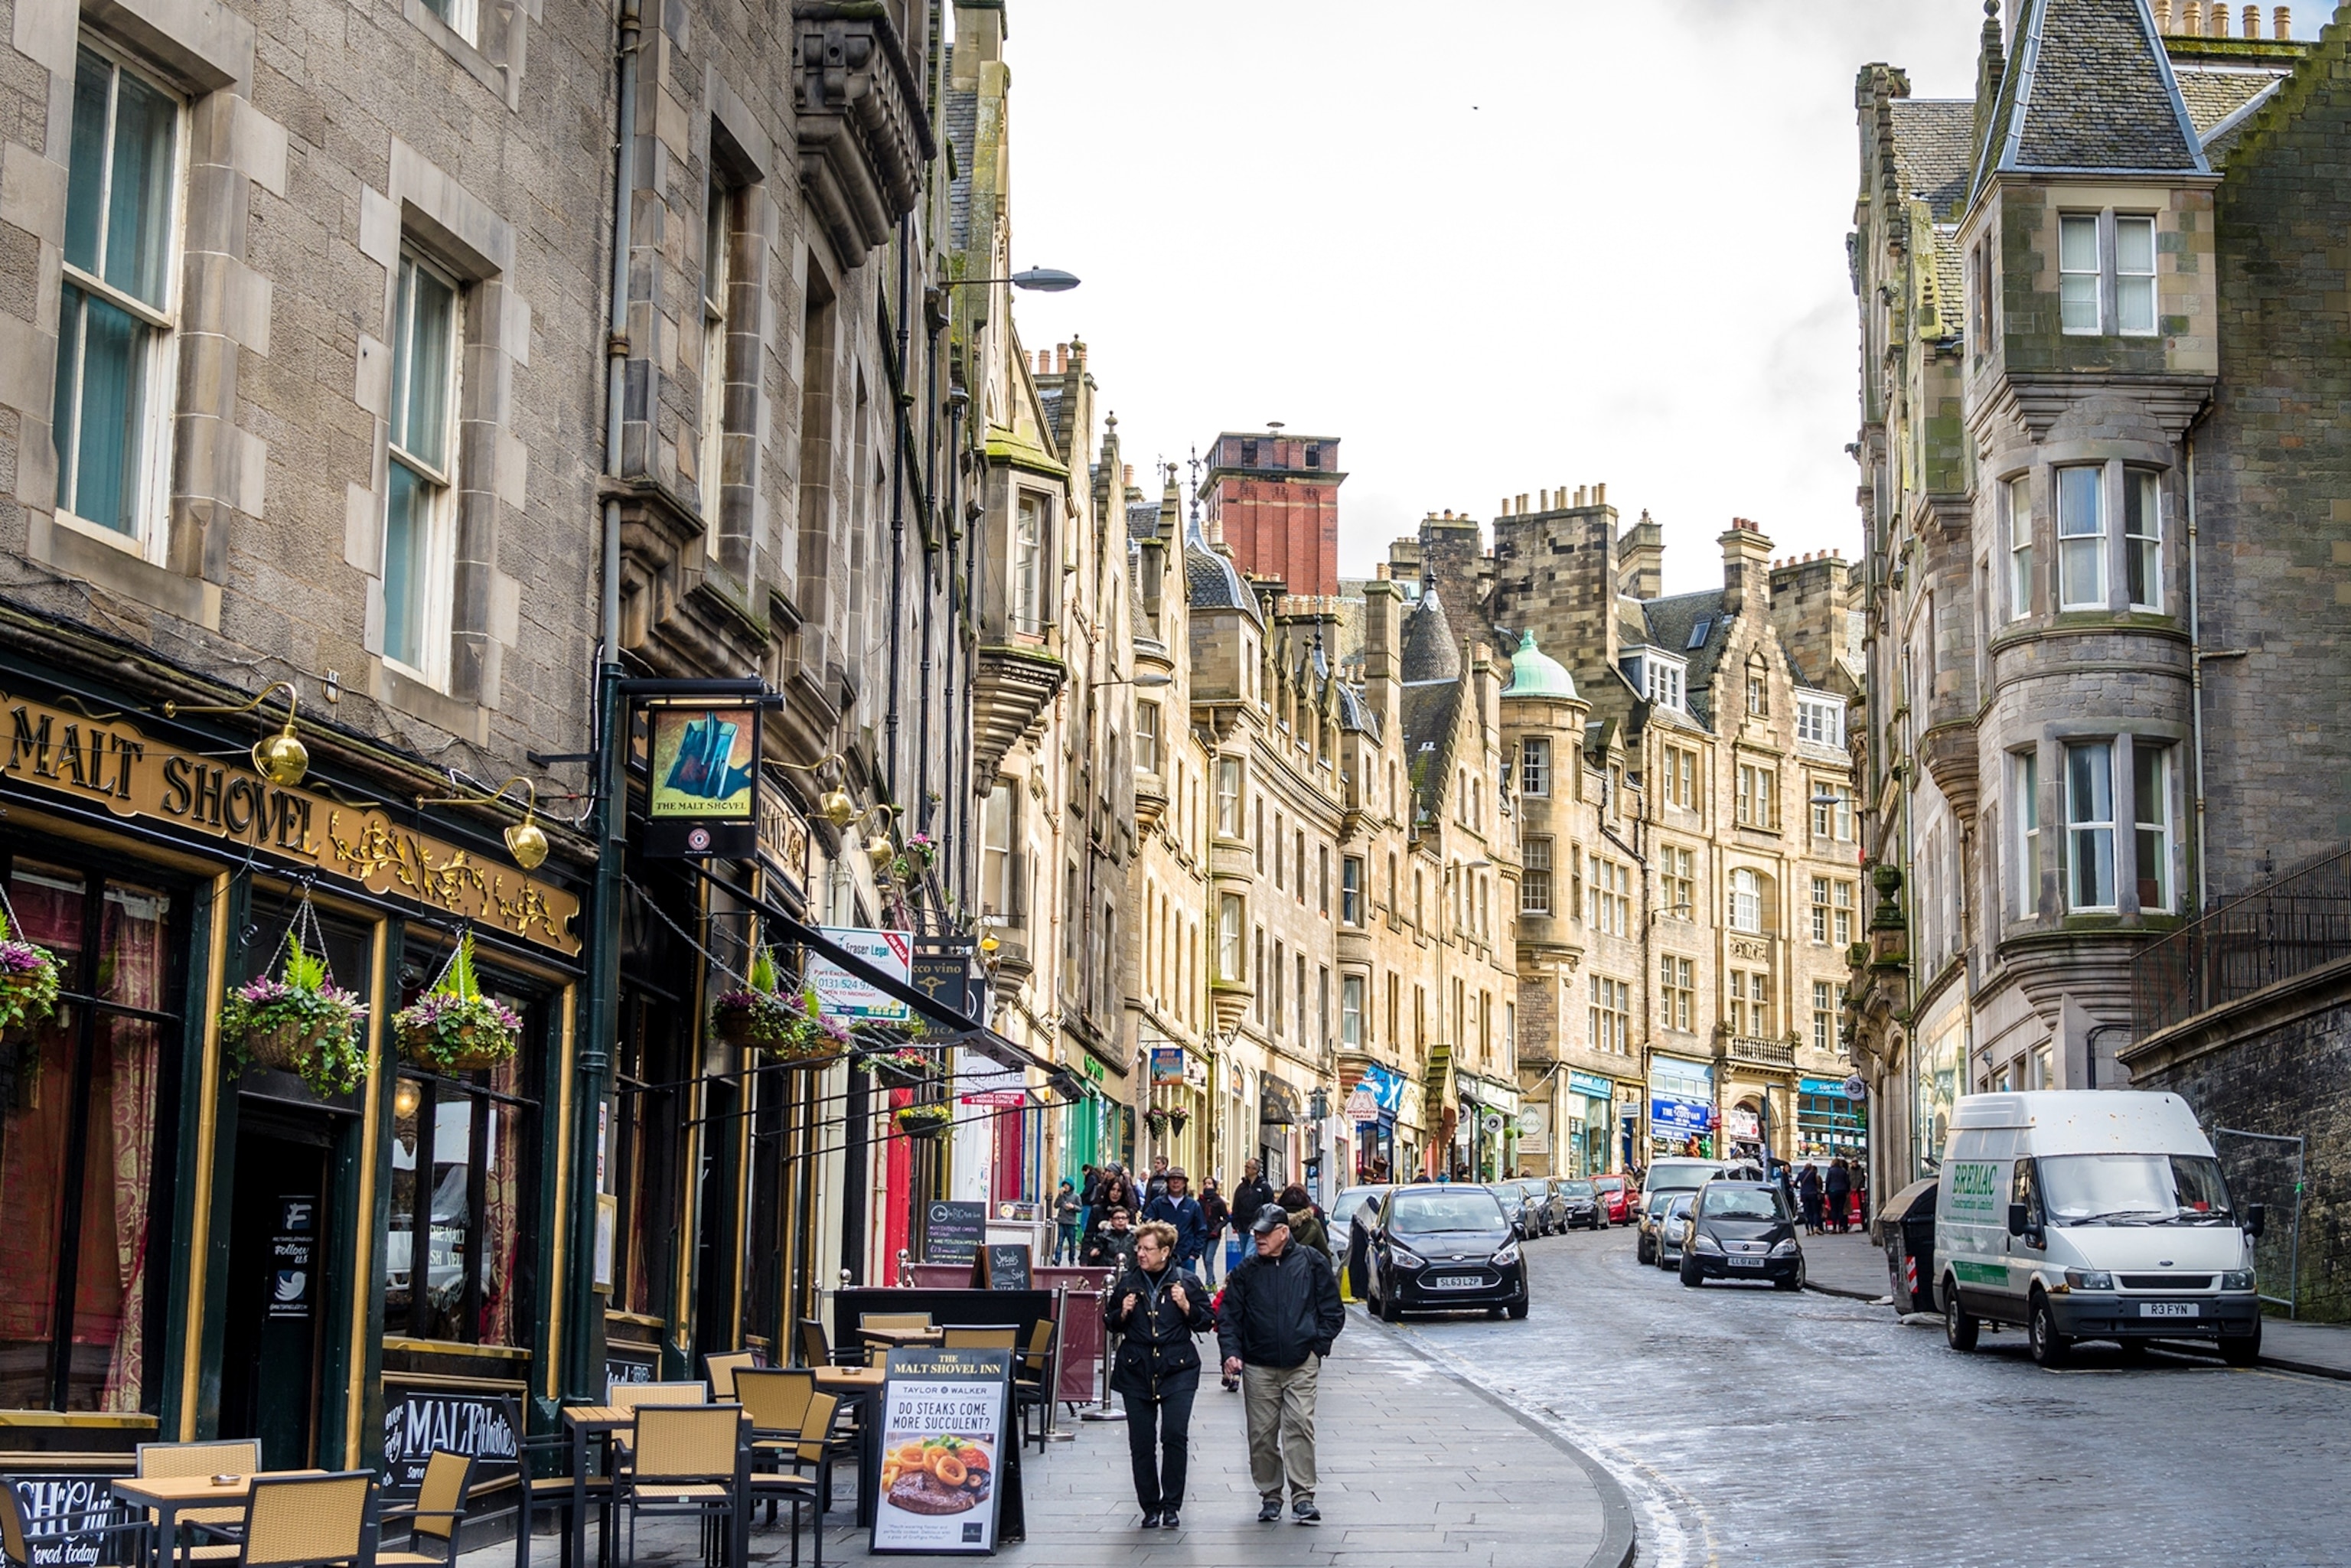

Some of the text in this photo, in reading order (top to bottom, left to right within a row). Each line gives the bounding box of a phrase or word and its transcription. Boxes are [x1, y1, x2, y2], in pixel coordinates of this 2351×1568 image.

[8, 706, 320, 858] MALT SHOVEL
[656, 801, 747, 810] THE MALT SHOVEL
[758, 798, 788, 862] HOVEL
[846, 940, 889, 958] Fraser Legal
[886, 934, 908, 960] FOR SALE
[934, 962, 961, 973] vino
[818, 978, 878, 990] 0131 524 97
[848, 990, 876, 999] MIDNIGHT
[966, 1066, 1022, 1083] Gurkha
[1952, 1165, 1997, 1195] BREMAC
[1951, 1197, 1994, 1211] Construction Limited
[275, 1244, 309, 1255] Follow
[2151, 1305, 2187, 1315] R3 FYN
[895, 1364, 1001, 1374] MALT SHOVEL INN
[899, 1403, 986, 1416] DO STEAKS COME
[403, 1400, 482, 1456] MALT
[893, 1416, 990, 1429] MORE SUCCULENT?
[65, 1543, 99, 1567] today
